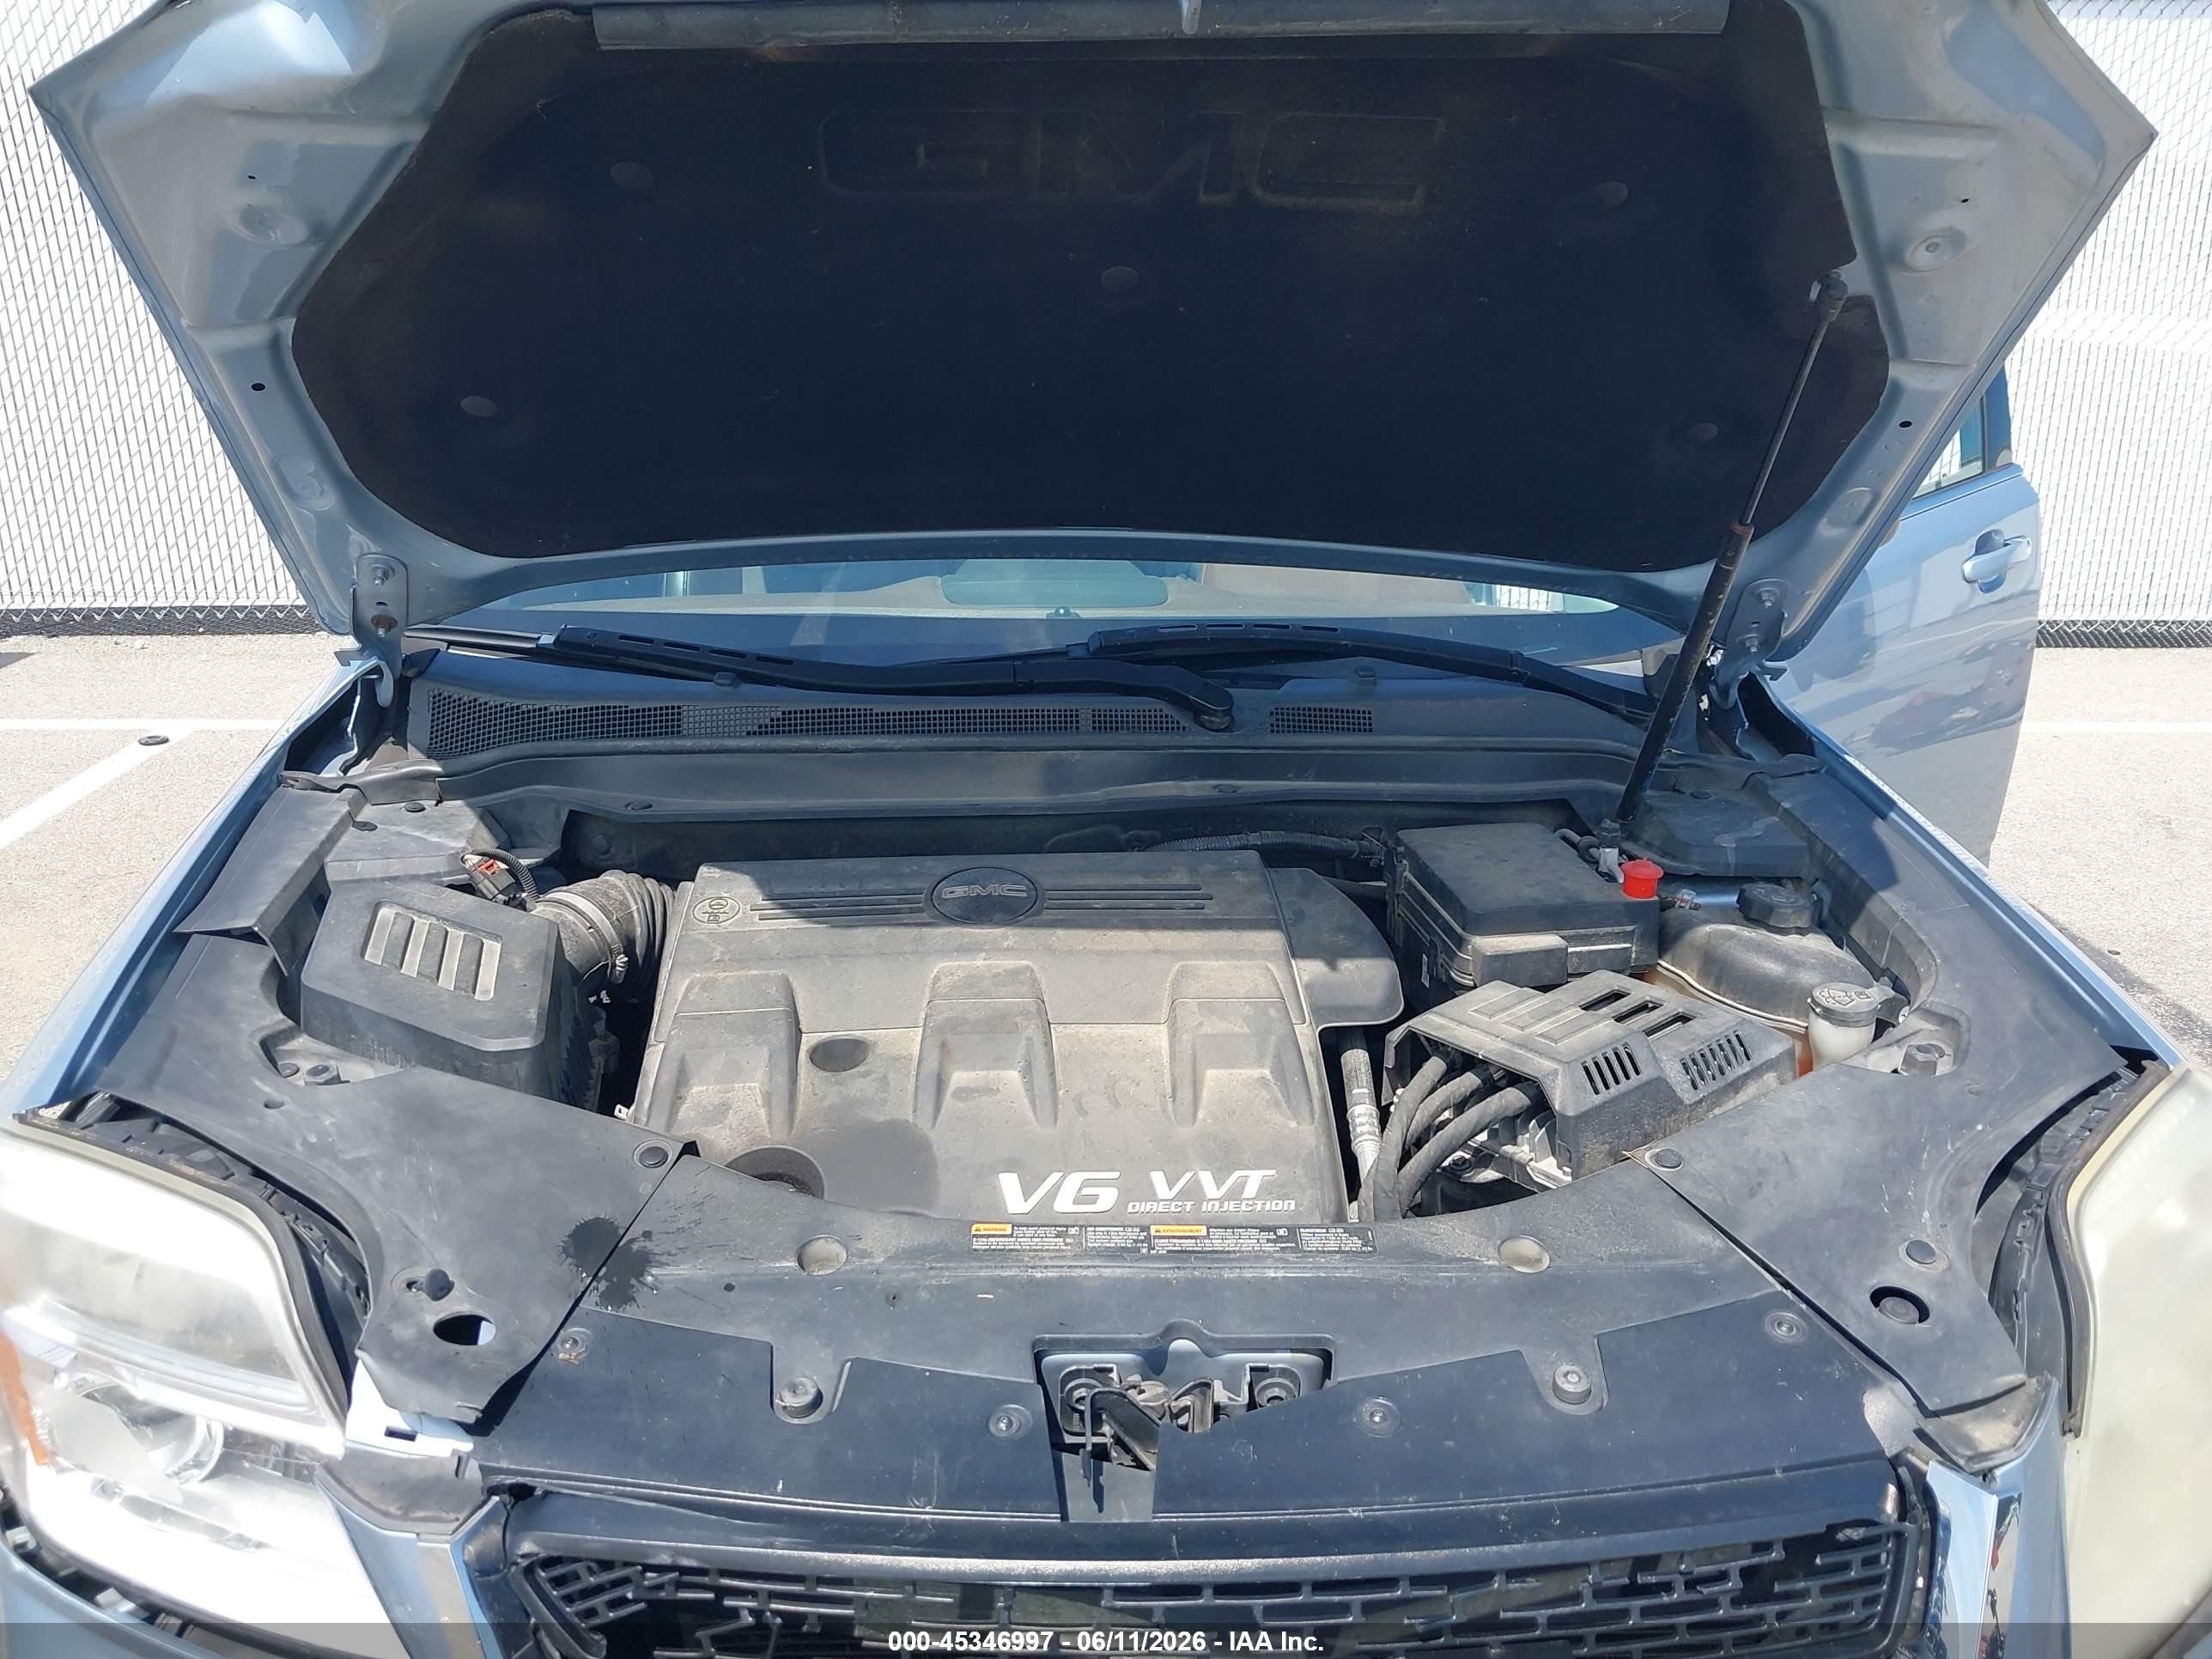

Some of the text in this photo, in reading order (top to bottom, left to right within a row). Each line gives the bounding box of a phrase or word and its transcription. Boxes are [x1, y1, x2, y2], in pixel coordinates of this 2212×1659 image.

[819, 109, 1445, 216] GMC
[941, 884, 1028, 899] GMC
[998, 1170, 1121, 1216] V6
[1150, 1169, 1278, 1200] VVT
[1127, 1199, 1297, 1215] DIRECT INJECTION
